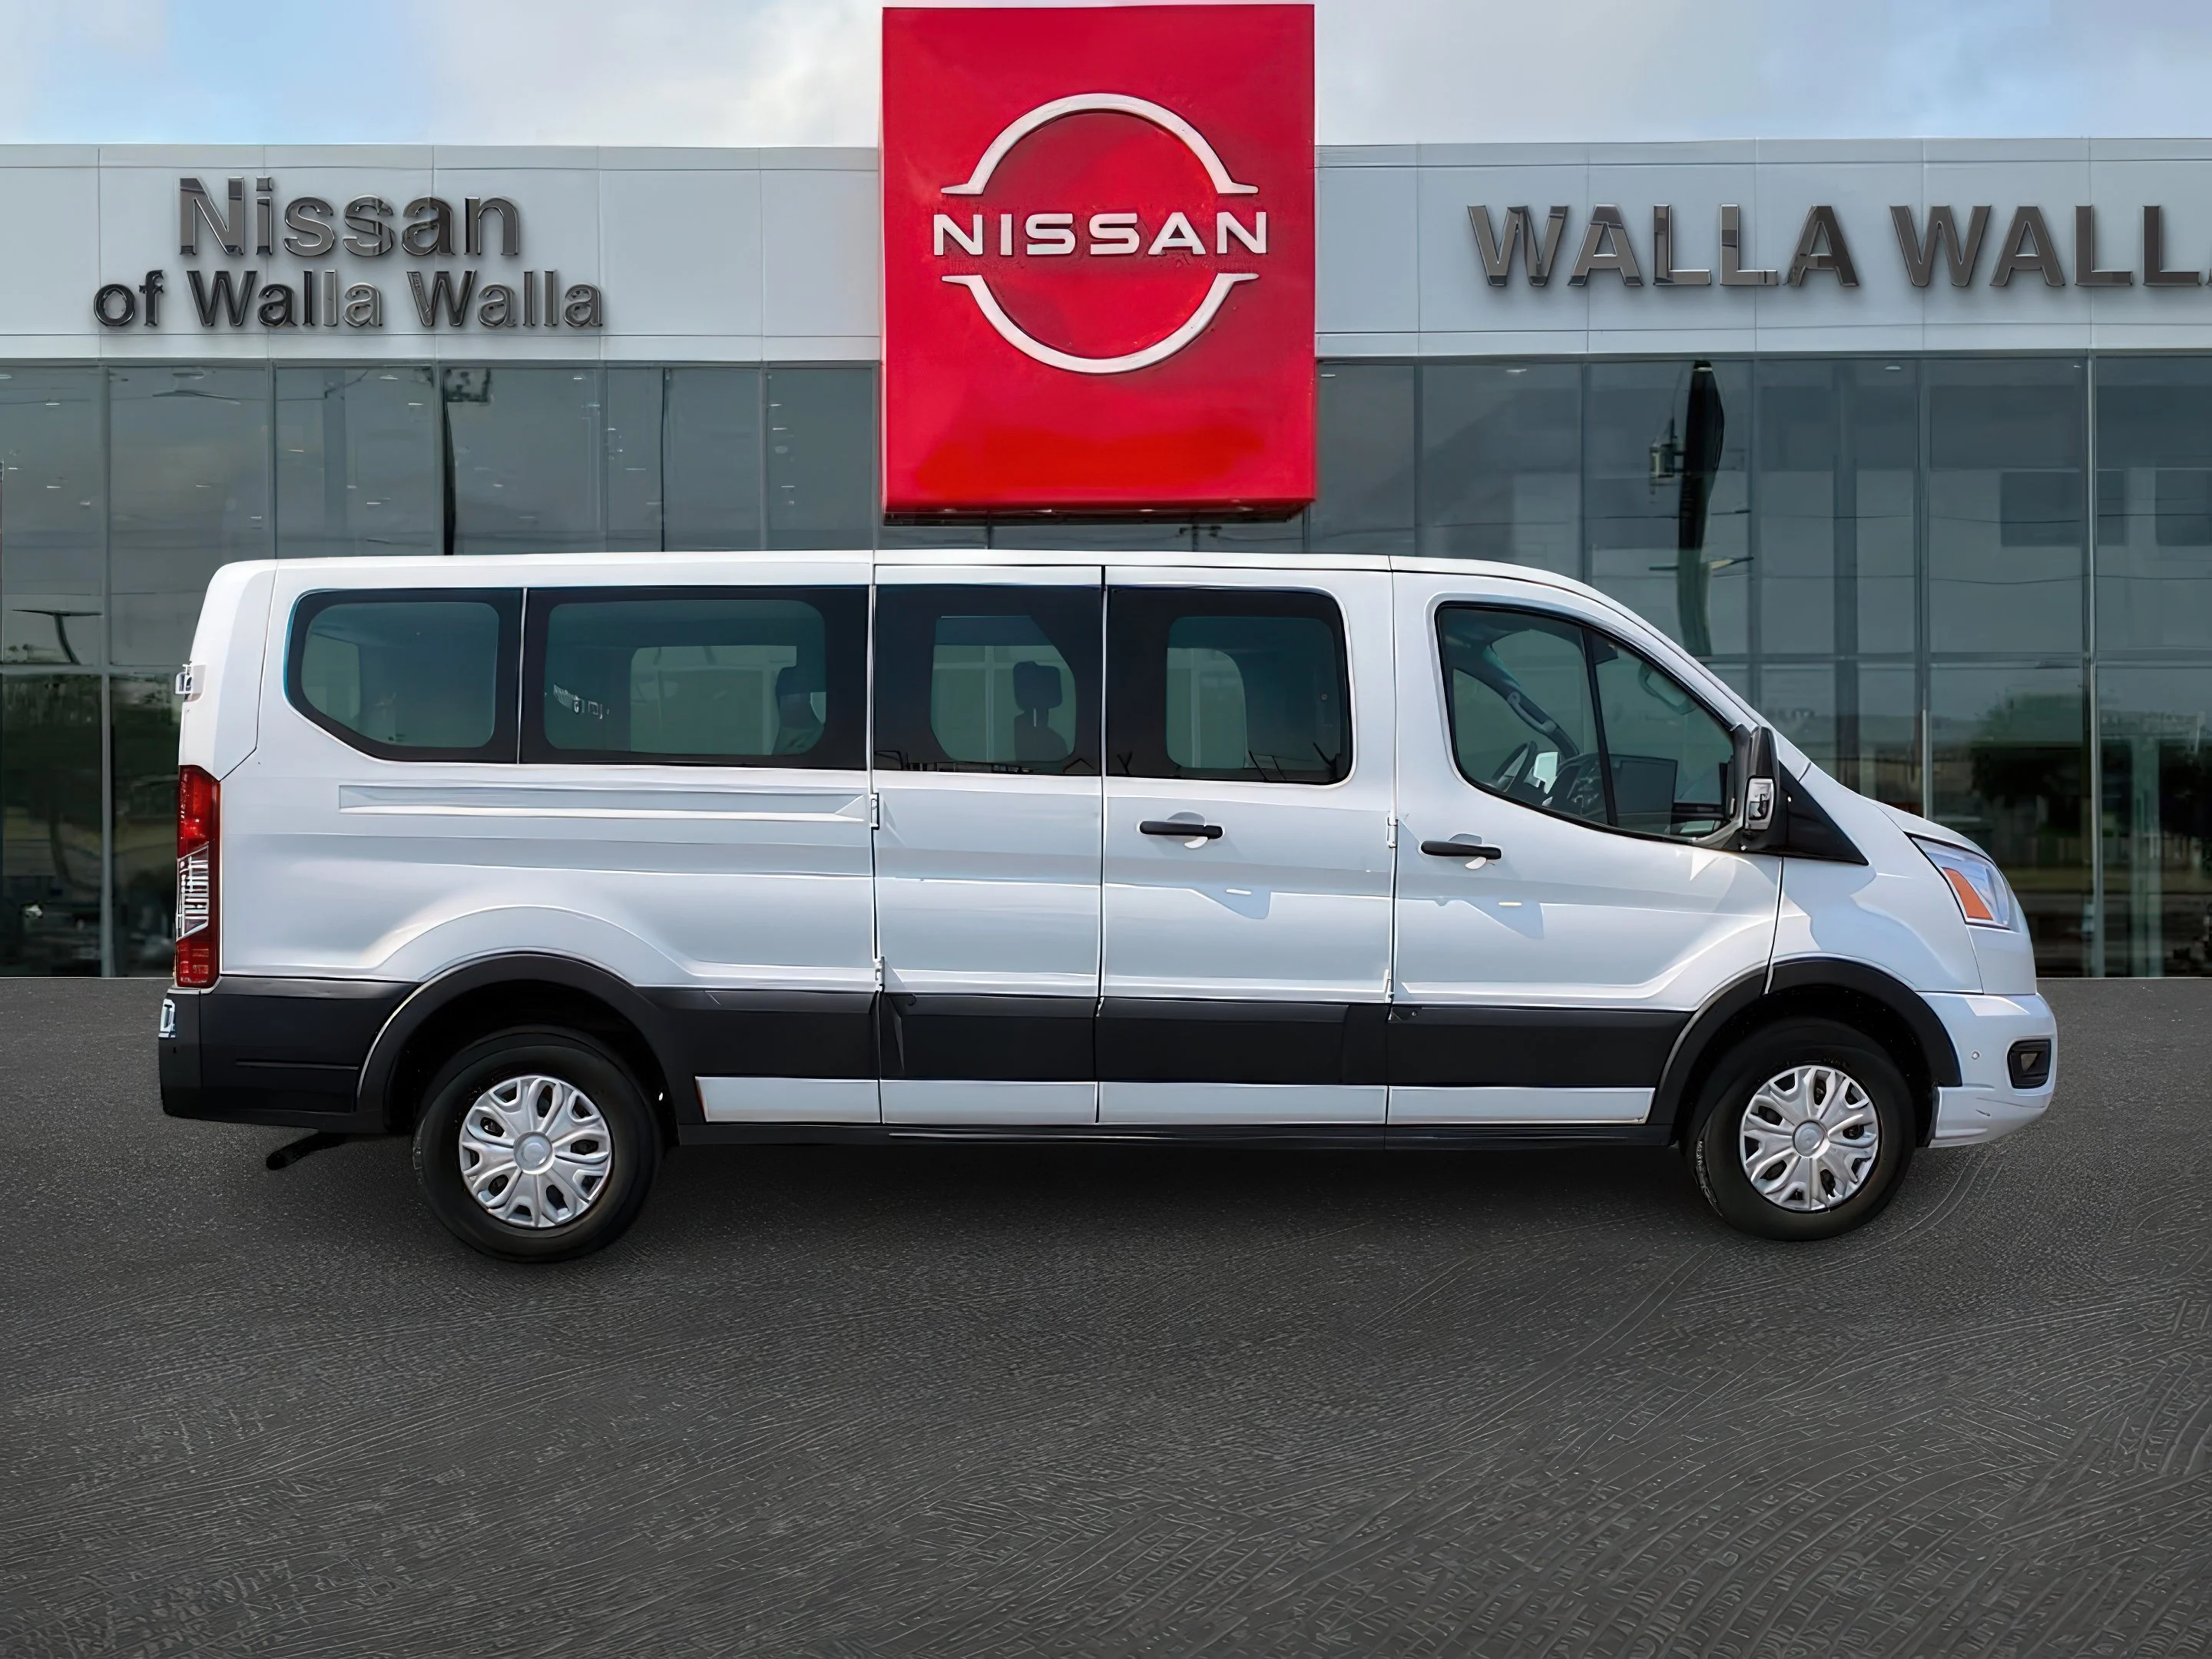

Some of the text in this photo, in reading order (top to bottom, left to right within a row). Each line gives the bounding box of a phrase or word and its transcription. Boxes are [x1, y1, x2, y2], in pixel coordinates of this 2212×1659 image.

[178, 177, 519, 256] Nissan
[933, 211, 1267, 256] NISSAN
[1466, 204, 2212, 286] WALLA WALL
[94, 269, 603, 327] of Walla Walla
